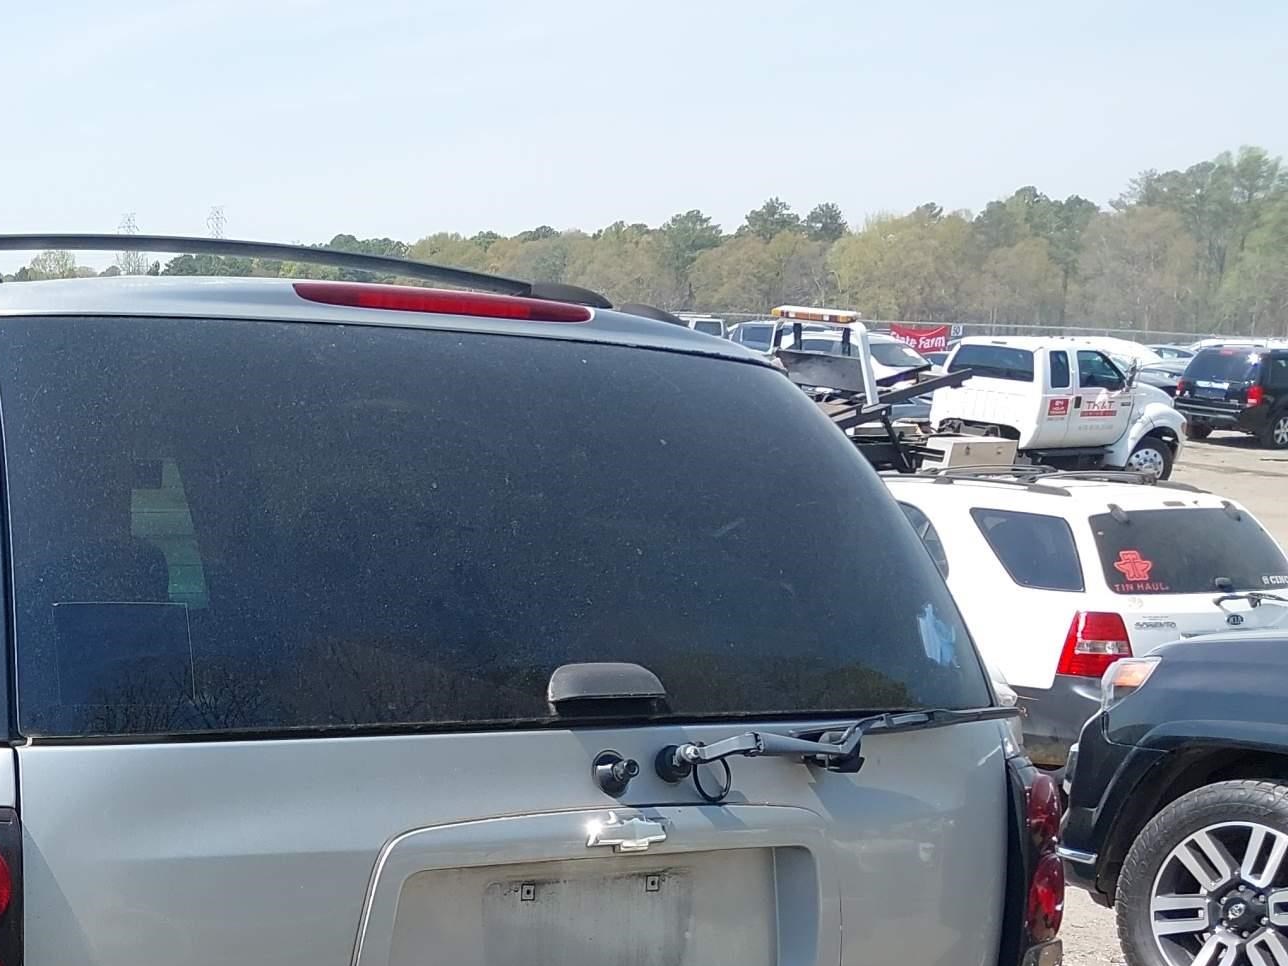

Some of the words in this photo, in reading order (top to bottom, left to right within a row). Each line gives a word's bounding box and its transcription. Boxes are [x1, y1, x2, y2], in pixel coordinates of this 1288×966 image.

[918, 336, 946, 349] Farm
[1114, 584, 1134, 592] TIN
[1137, 583, 1164, 591] HAUL
